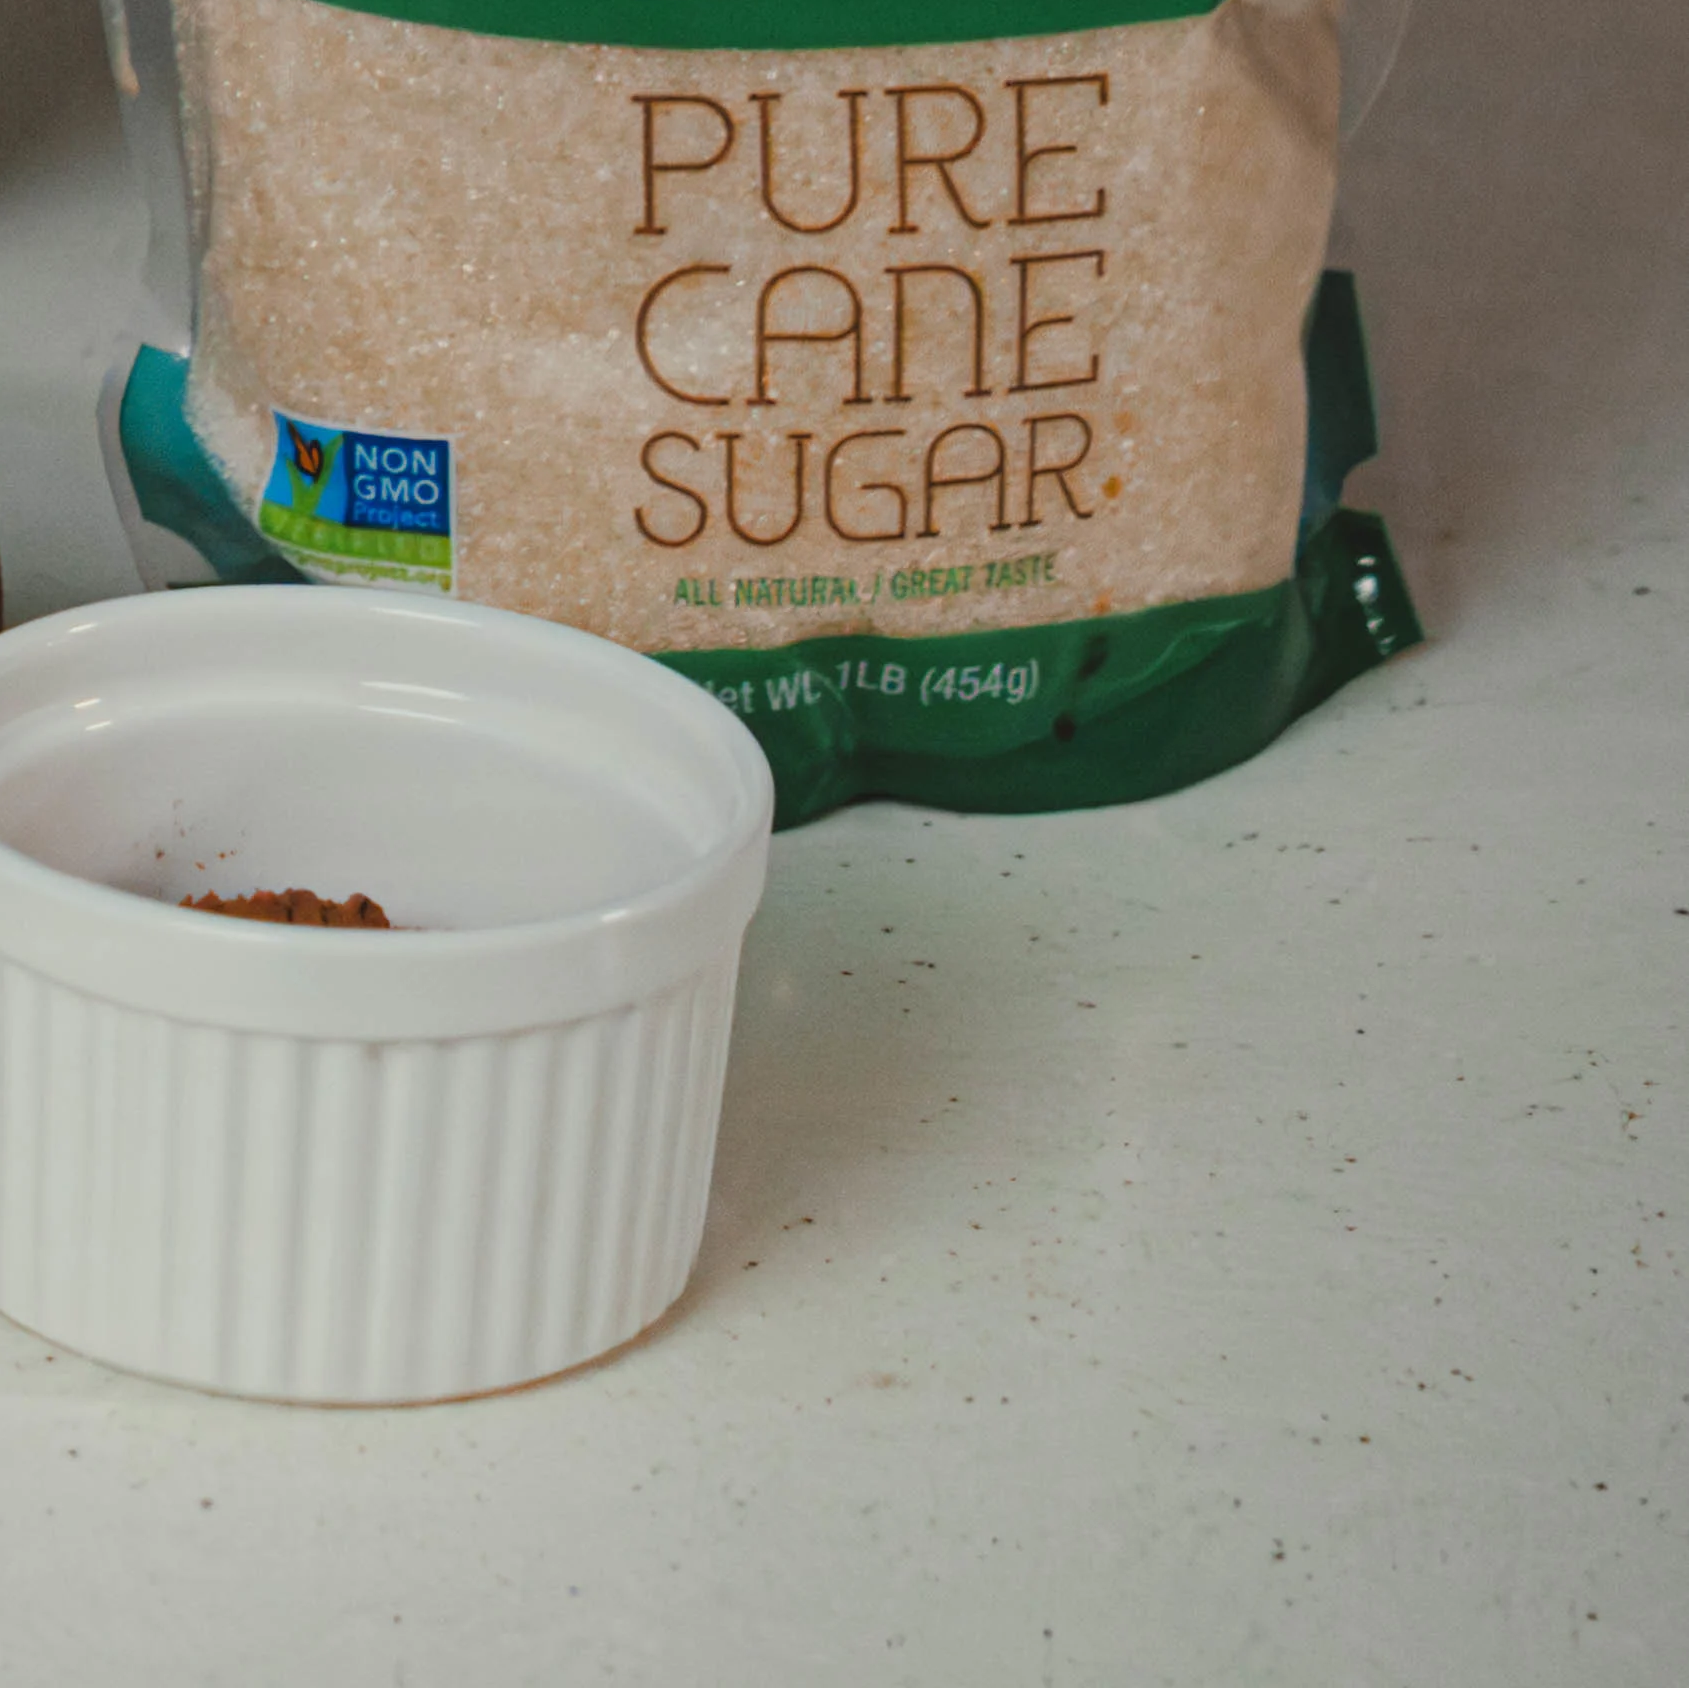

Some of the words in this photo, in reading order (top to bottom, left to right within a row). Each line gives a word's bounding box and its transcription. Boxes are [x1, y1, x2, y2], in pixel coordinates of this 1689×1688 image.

[630, 72, 1110, 236] PURE
[634, 249, 1105, 406] CANE
[353, 443, 437, 476] NON
[633, 413, 1093, 548] SUGAR
[353, 474, 440, 505] GMO
[353, 500, 440, 530] Project
[674, 577, 721, 606] ALL
[734, 576, 861, 607] NATURAL
[891, 565, 973, 600] GREAT
[984, 552, 1057, 588] TASTE
[836, 659, 908, 695] 1LB
[920, 657, 1040, 707] (454g)
